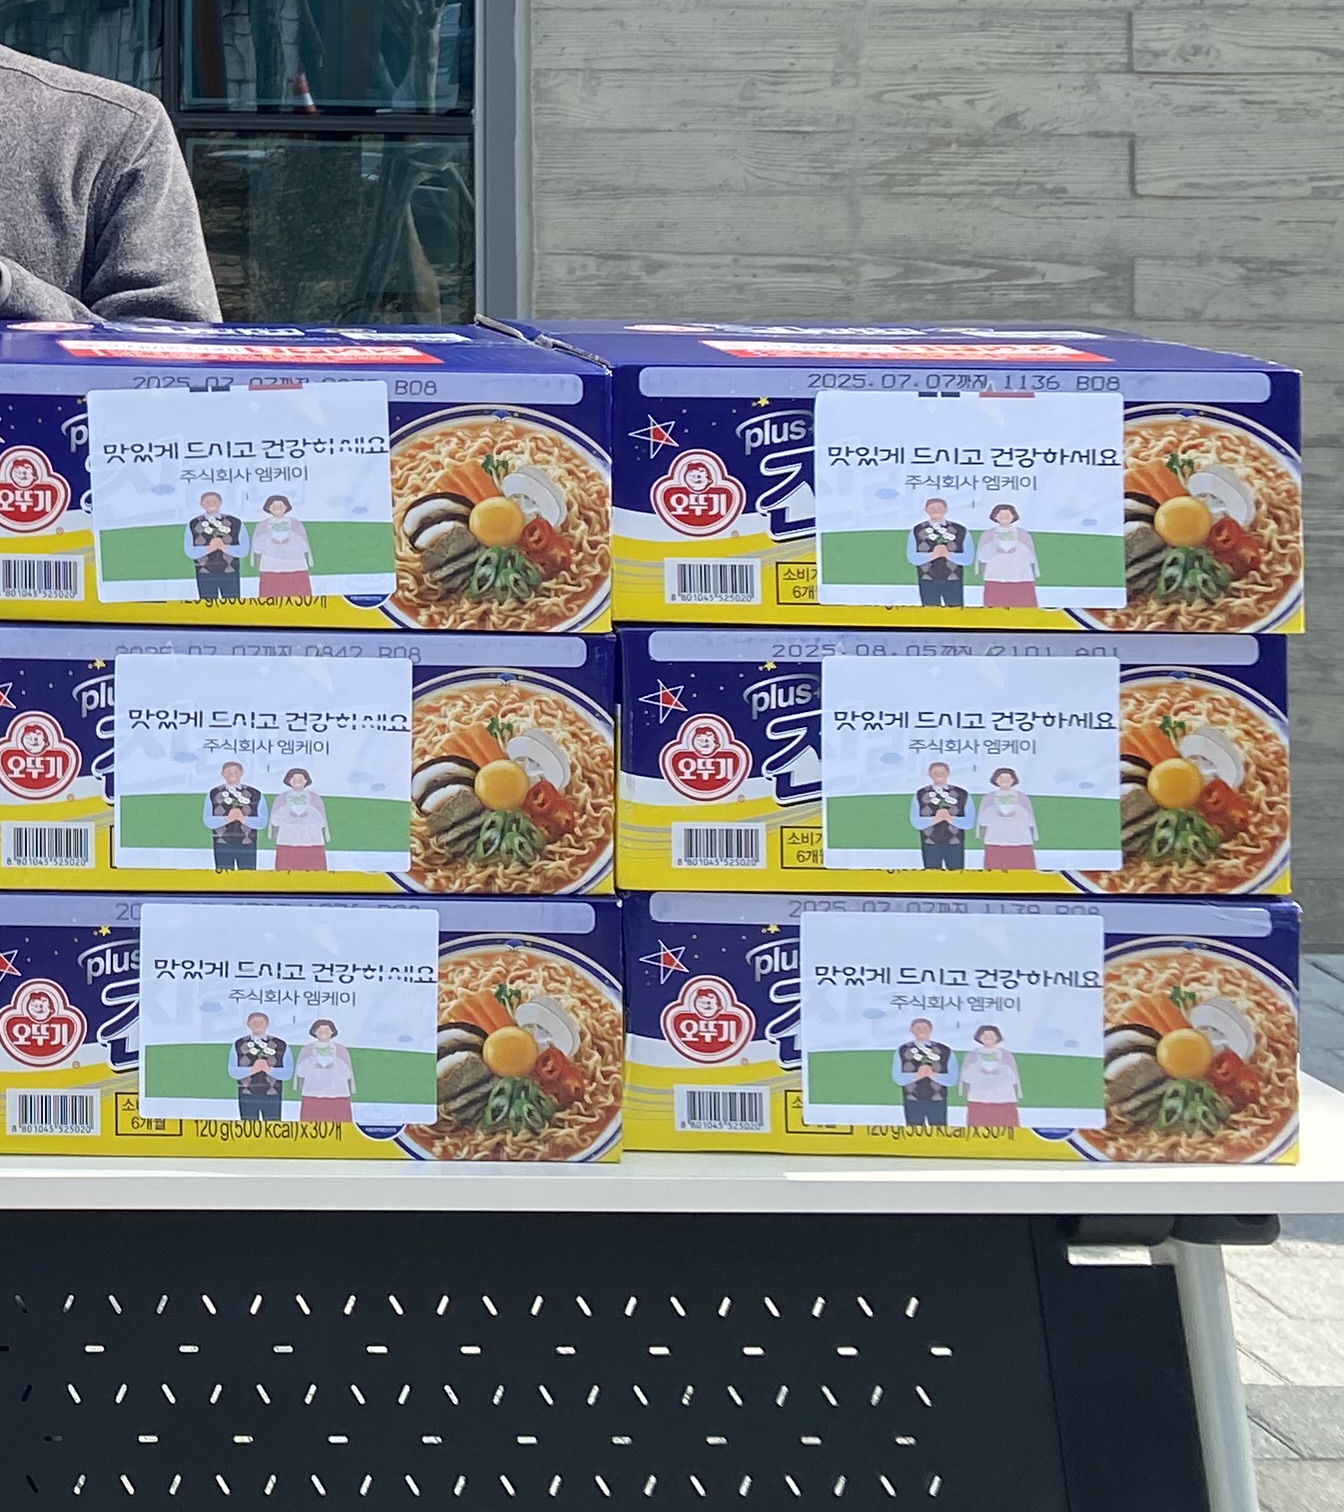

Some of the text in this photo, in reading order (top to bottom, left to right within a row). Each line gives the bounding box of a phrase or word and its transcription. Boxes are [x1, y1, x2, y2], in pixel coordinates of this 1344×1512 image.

[394, 379, 438, 397] B08
[1002, 374, 1061, 391] 1136
[1076, 375, 1120, 392] B08
[102, 435, 391, 464] 맛있게 드시고 건강하세요
[827, 444, 1121, 468] 맛있게 드시고 건강하세요
[178, 465, 309, 484] 주식회사 엠케이
[904, 474, 1038, 492] 주식회사 엠케이
[668, 492, 729, 518] 오뚜기
[128, 707, 412, 734] 맛있게 드시고 건강하세요
[833, 709, 1116, 733] 맛있게 드시고 건강하세요
[202, 736, 331, 757] 주식회사 엠케이
[908, 737, 1037, 755] 주식회사 엠케이
[7, 754, 65, 779] 오뚜기
[676, 755, 734, 782] 오뚜기
[152, 956, 439, 985] 맛있게 드시고 건강하세요
[814, 964, 1103, 989] 맛있게 드시고 건강하세요
[227, 987, 357, 1008] 주식회사 엠케이
[889, 994, 1022, 1015] 주식회사 엠케이
[11, 1022, 70, 1047] 오뚜기
[679, 1019, 738, 1045] 오뚜기
